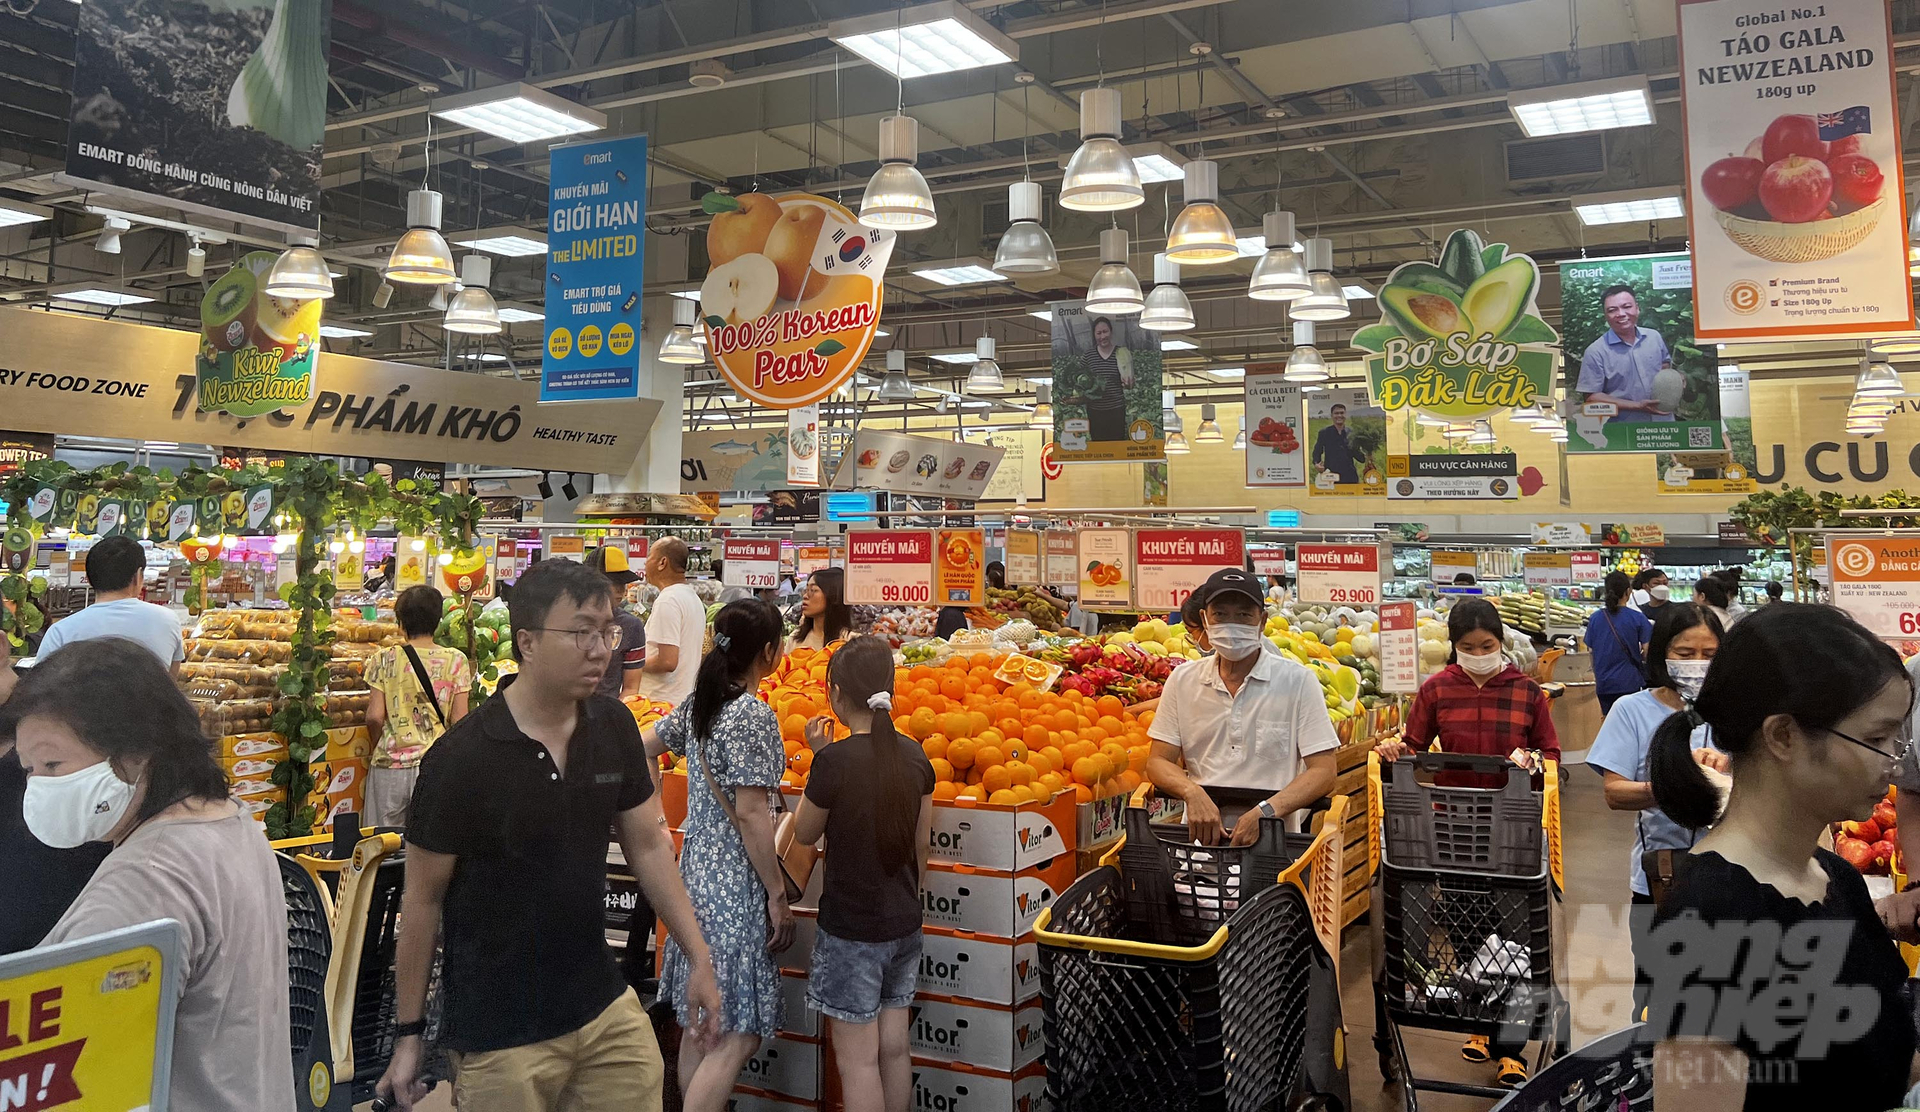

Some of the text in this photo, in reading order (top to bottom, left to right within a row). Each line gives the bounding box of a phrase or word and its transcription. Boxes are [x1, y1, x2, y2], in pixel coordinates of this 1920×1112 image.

[1735, 6, 1826, 28] Global No.1
[1720, 25, 1846, 57] TÁO GALA
[1698, 48, 1874, 86] NEWZEALAND
[1756, 83, 1816, 99] 180g up
[583, 151, 612, 165] emart
[78, 142, 313, 213] EMART ĐỒNG HÀNH CÙNG NÔNG DÂN VIỆT
[554, 180, 609, 200] KHUYẾN MÃI
[595, 200, 638, 231] HẠN
[552, 235, 637, 263] THE LIMITED
[1569, 267, 1604, 279] emart
[1782, 277, 1840, 286] Premium Brand
[564, 283, 621, 300] EMART TRỢ GIÁ
[1812, 287, 1828, 296] hiệu
[572, 300, 611, 315] TIÊU DÙNG
[1783, 299, 1799, 307] Size
[1802, 298, 1820, 306] 180g
[1862, 305, 1880, 313] 180g
[1058, 307, 1083, 317] emart
[712, 302, 877, 356] 100% Korean
[1384, 332, 1518, 372] Bơ Sáp
[234, 347, 282, 380] Kiwi
[754, 348, 829, 389] Pear
[26, 372, 89, 392] FOOD
[91, 379, 149, 398] ZONE
[201, 370, 310, 408] Newzeland
[1260, 387, 1279, 395] CHUA
[1380, 368, 1537, 411] Đắk Lắk
[1273, 395, 1285, 404] LẠT
[305, 384, 437, 435] PHẨM
[437, 405, 522, 443] KHÔ
[532, 427, 618, 446] HEALTHY TASTE
[413, 466, 441, 480] Korean
[1391, 462, 1404, 470] VND
[1419, 460, 1508, 471] KHU VỰC CÂN HÀNG
[1443, 488, 1466, 496] HƯỚNG
[1467, 488, 1480, 496] NÀY
[727, 543, 770, 555] KHUYẾN MÃI
[853, 538, 919, 555] KHUYẾN MÃI
[1142, 537, 1225, 555] KHUYẾN MÃI
[1301, 550, 1364, 564] KHUYẾN MÃI
[745, 574, 775, 586] 12.700
[882, 585, 929, 601] 99.000
[1330, 589, 1374, 603] 29.900
[1017, 827, 1042, 853] Vitor
[921, 888, 1041, 919] itor Vitor
[919, 953, 959, 981] itor
